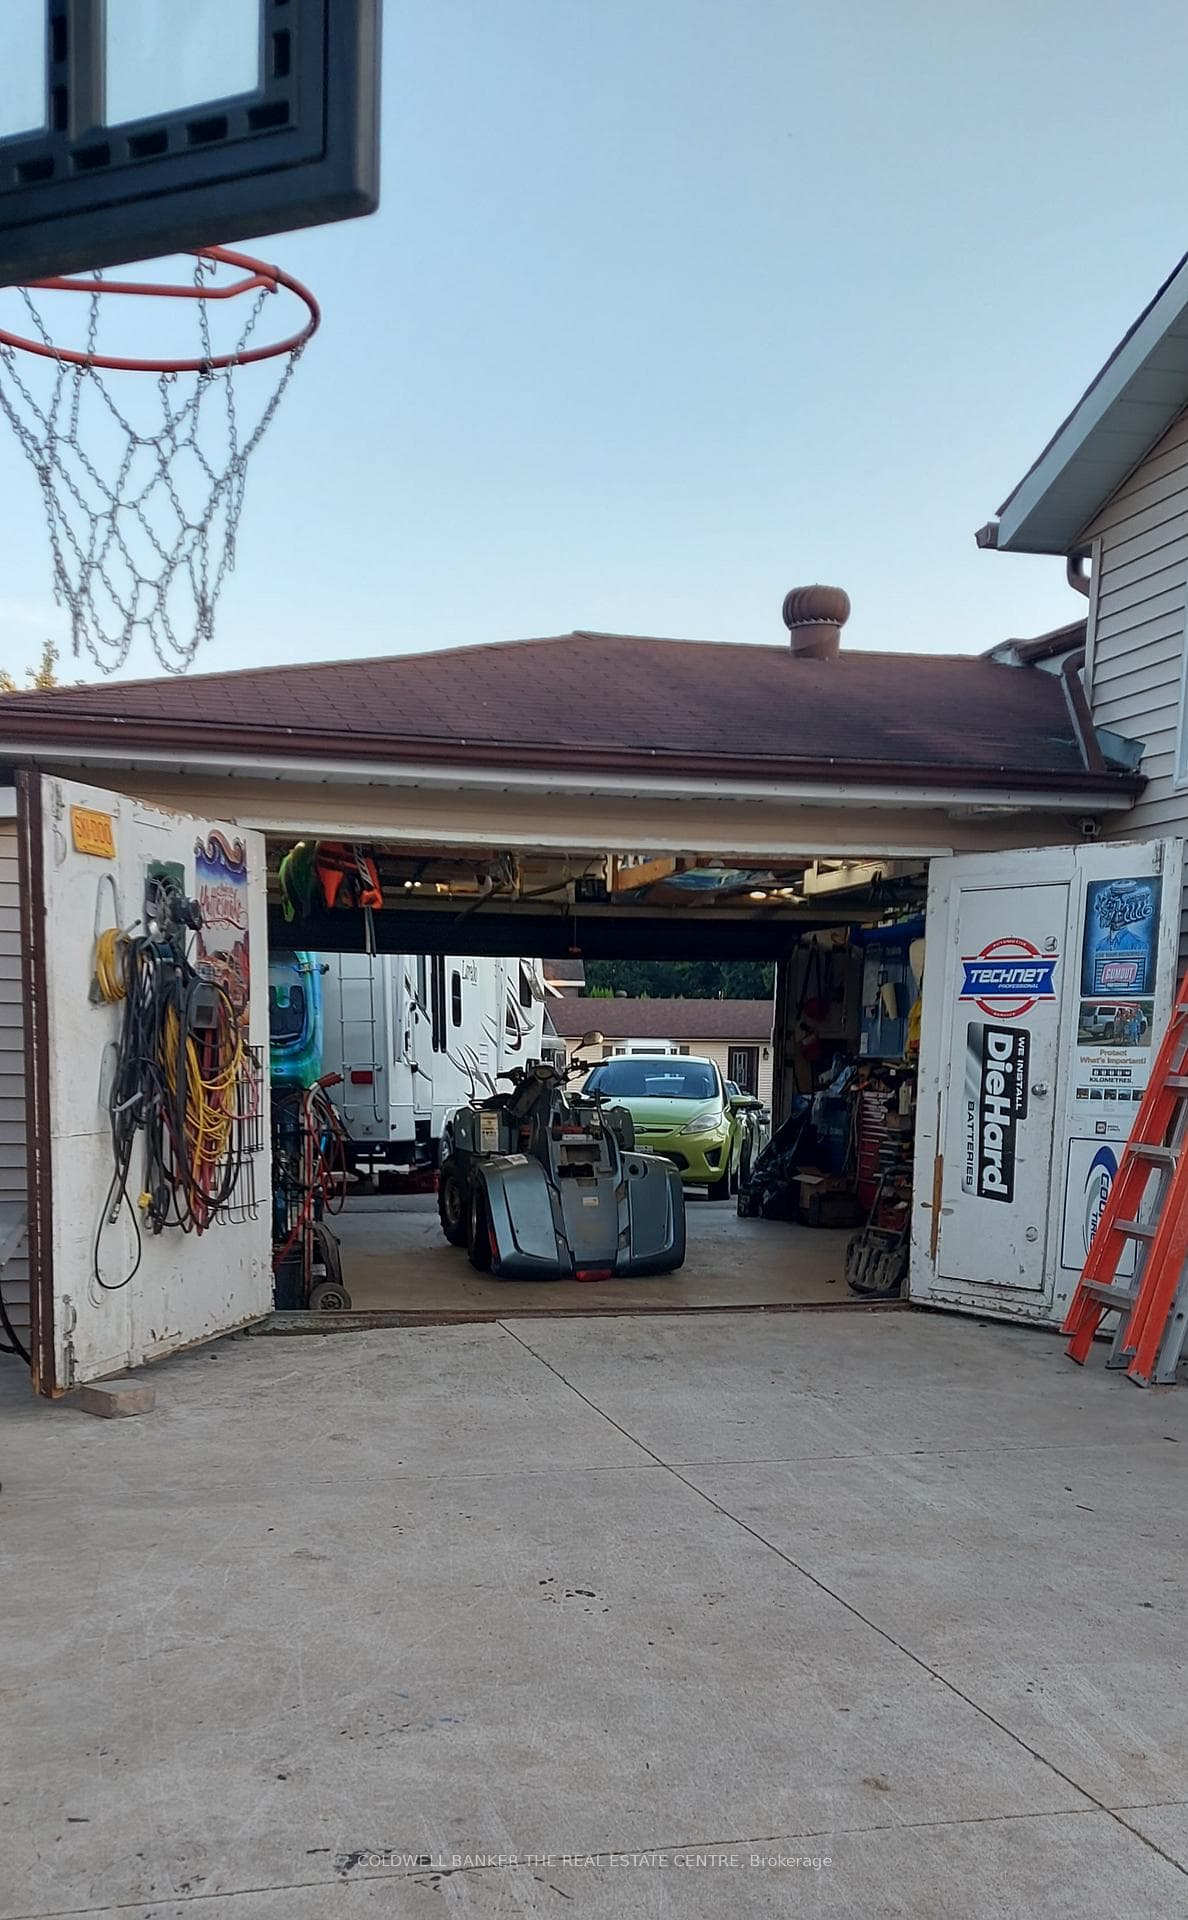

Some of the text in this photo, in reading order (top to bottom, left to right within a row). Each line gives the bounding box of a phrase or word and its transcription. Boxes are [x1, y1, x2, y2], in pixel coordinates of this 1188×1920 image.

[970, 968, 1049, 983] TECHNET
[1015, 1036, 1026, 1111] WE INSTALL
[1080, 1056, 1106, 1064] What's
[966, 1101, 975, 1186] BATTERIES
[983, 1031, 1014, 1194] DieHard
